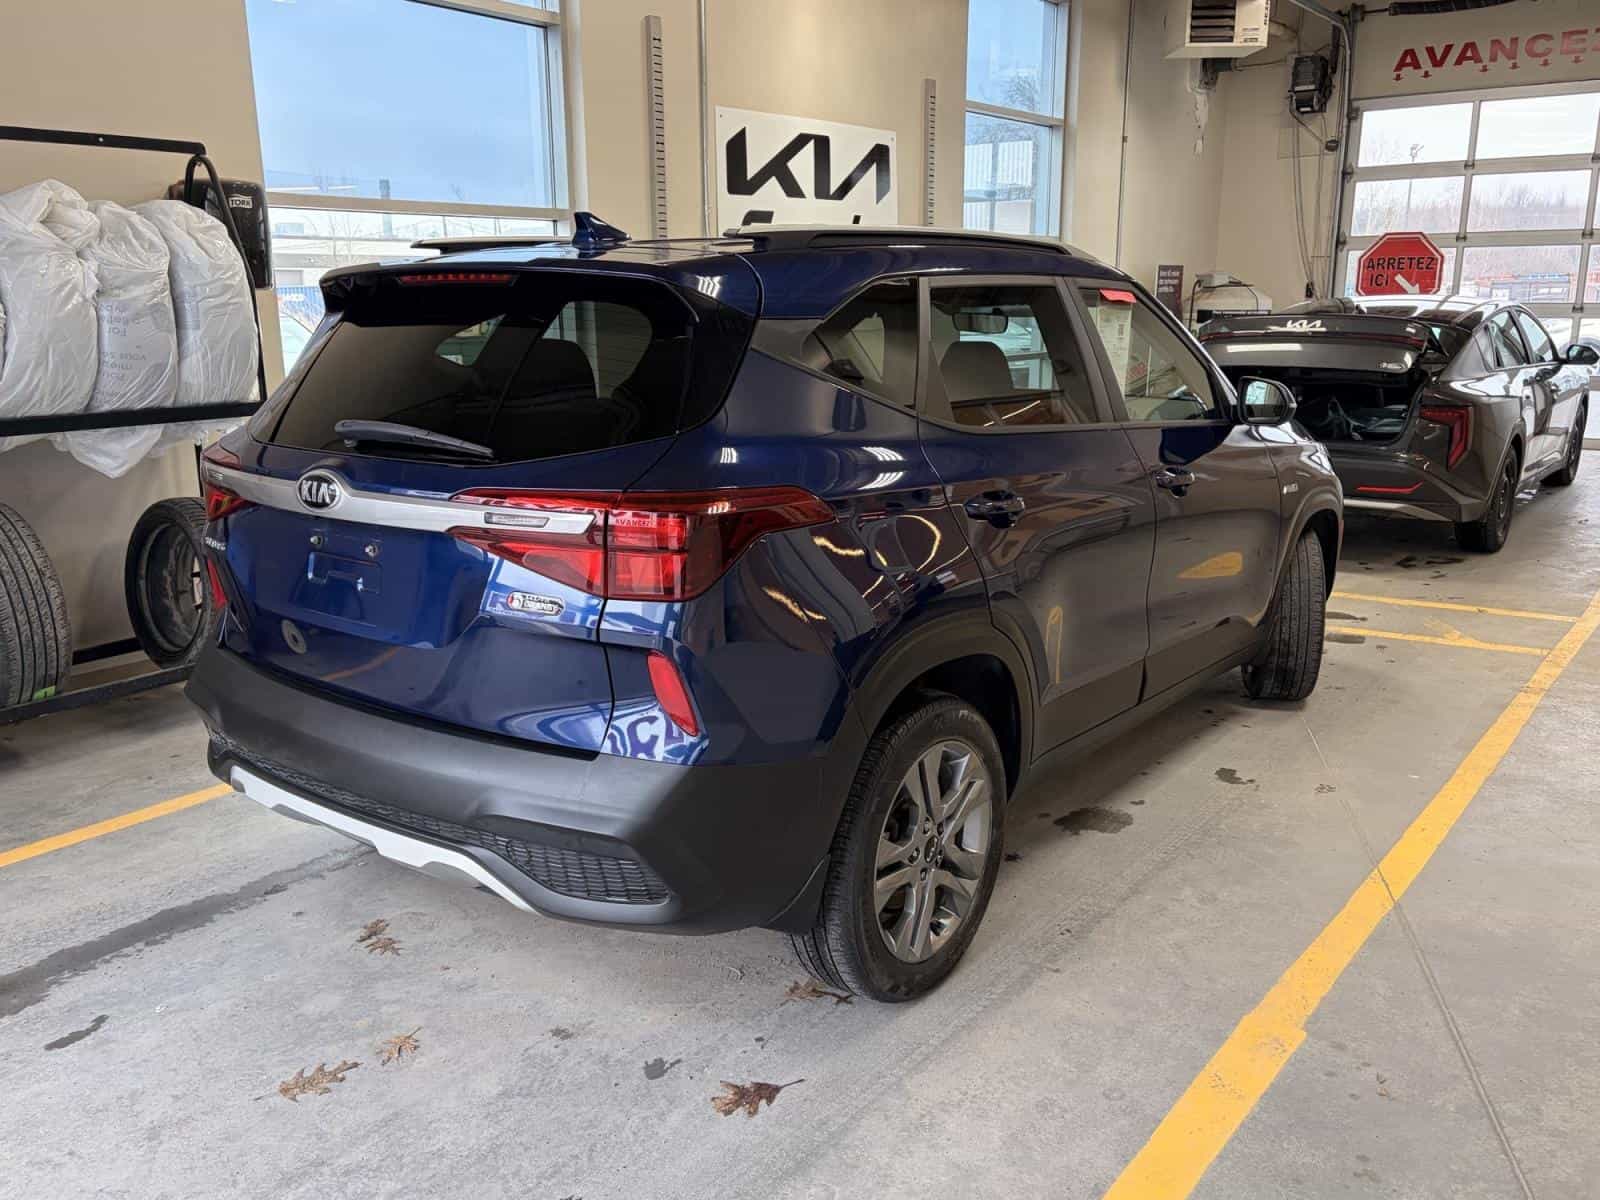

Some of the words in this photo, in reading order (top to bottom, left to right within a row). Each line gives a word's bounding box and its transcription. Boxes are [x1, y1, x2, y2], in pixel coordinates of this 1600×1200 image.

[725, 126, 890, 205] KIA
[1366, 256, 1435, 271] ARRETEZ
[1369, 273, 1390, 288] ICI
[1286, 319, 1322, 330] KIA
[301, 480, 331, 504] KIA
